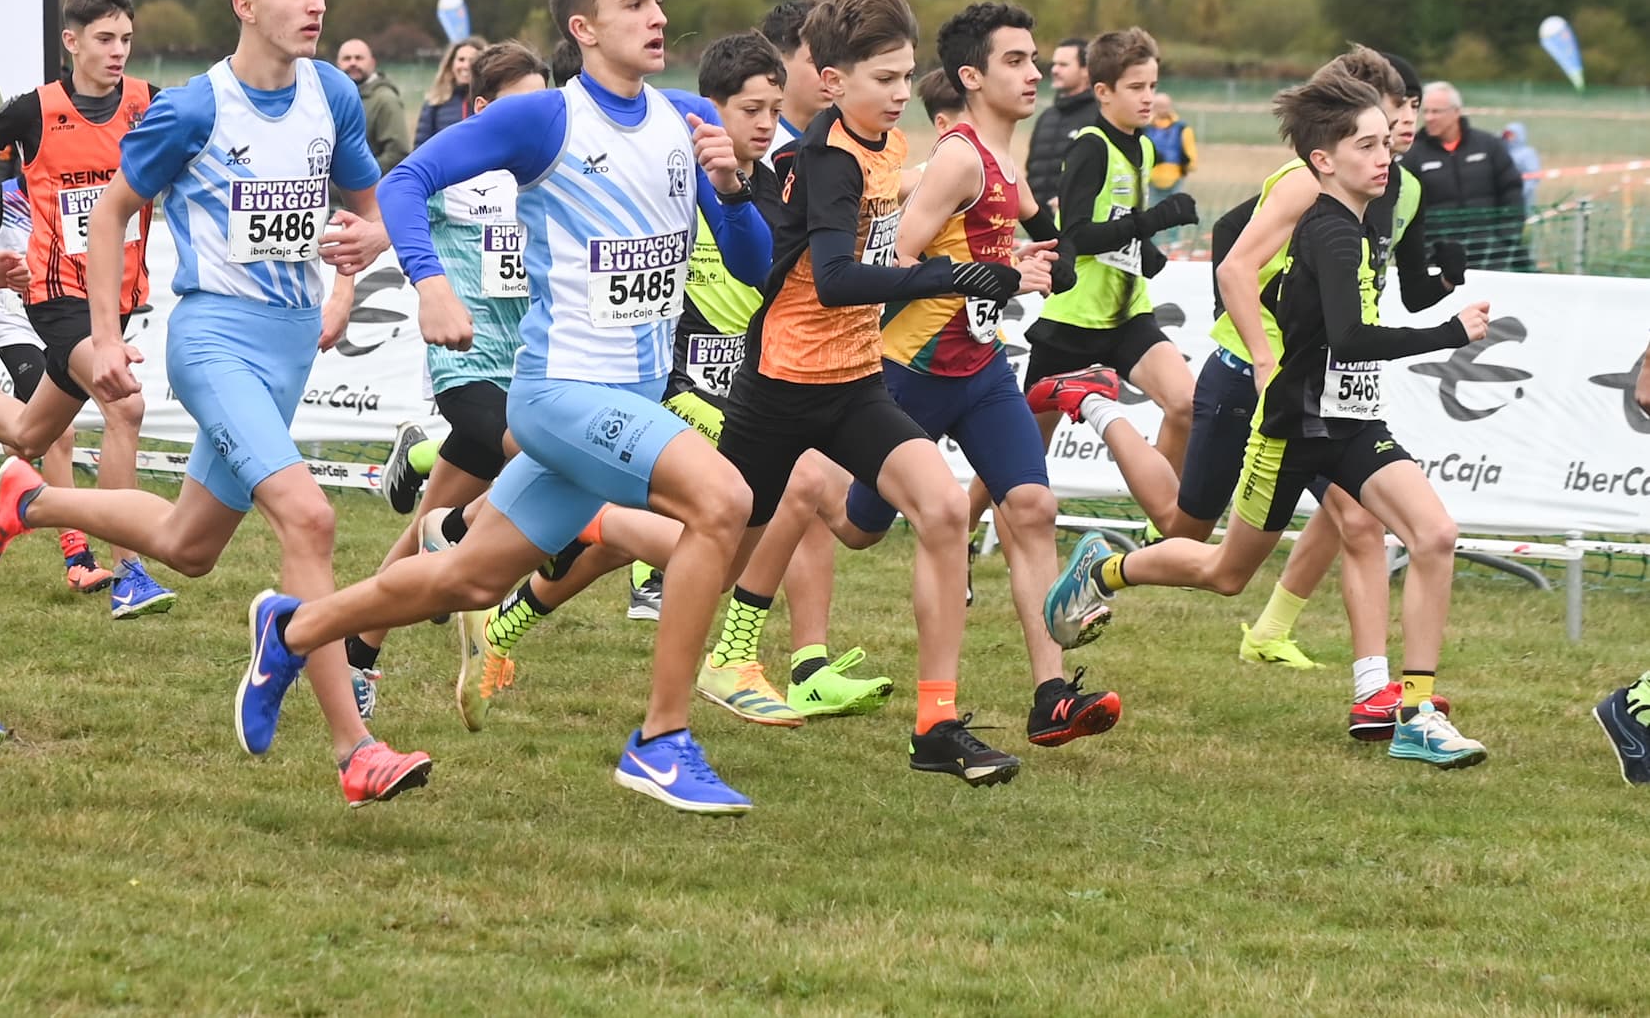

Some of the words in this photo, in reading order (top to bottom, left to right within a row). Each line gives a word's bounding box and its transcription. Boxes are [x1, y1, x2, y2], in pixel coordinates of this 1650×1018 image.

[240, 192, 323, 210] BURGOS
[248, 211, 315, 243] 5486
[599, 245, 684, 271] BURGOS
[608, 268, 677, 305] 5485
[703, 364, 740, 391] 54
